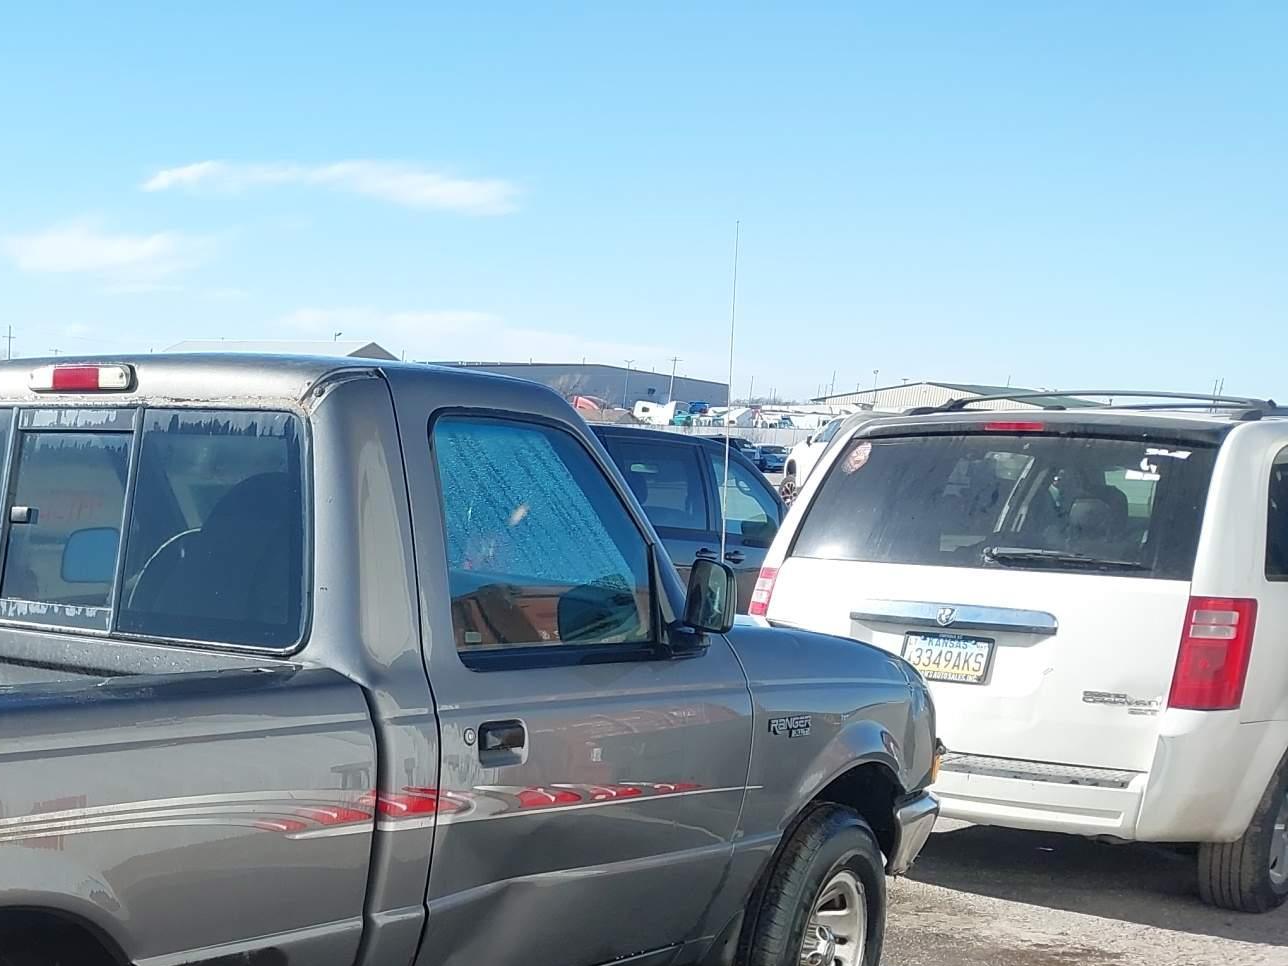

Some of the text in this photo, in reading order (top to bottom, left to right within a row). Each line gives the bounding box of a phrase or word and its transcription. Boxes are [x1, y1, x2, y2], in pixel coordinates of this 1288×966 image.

[927, 637, 968, 650] KANSAS
[912, 647, 984, 673] 3349AKS
[768, 714, 812, 735] RANGER
